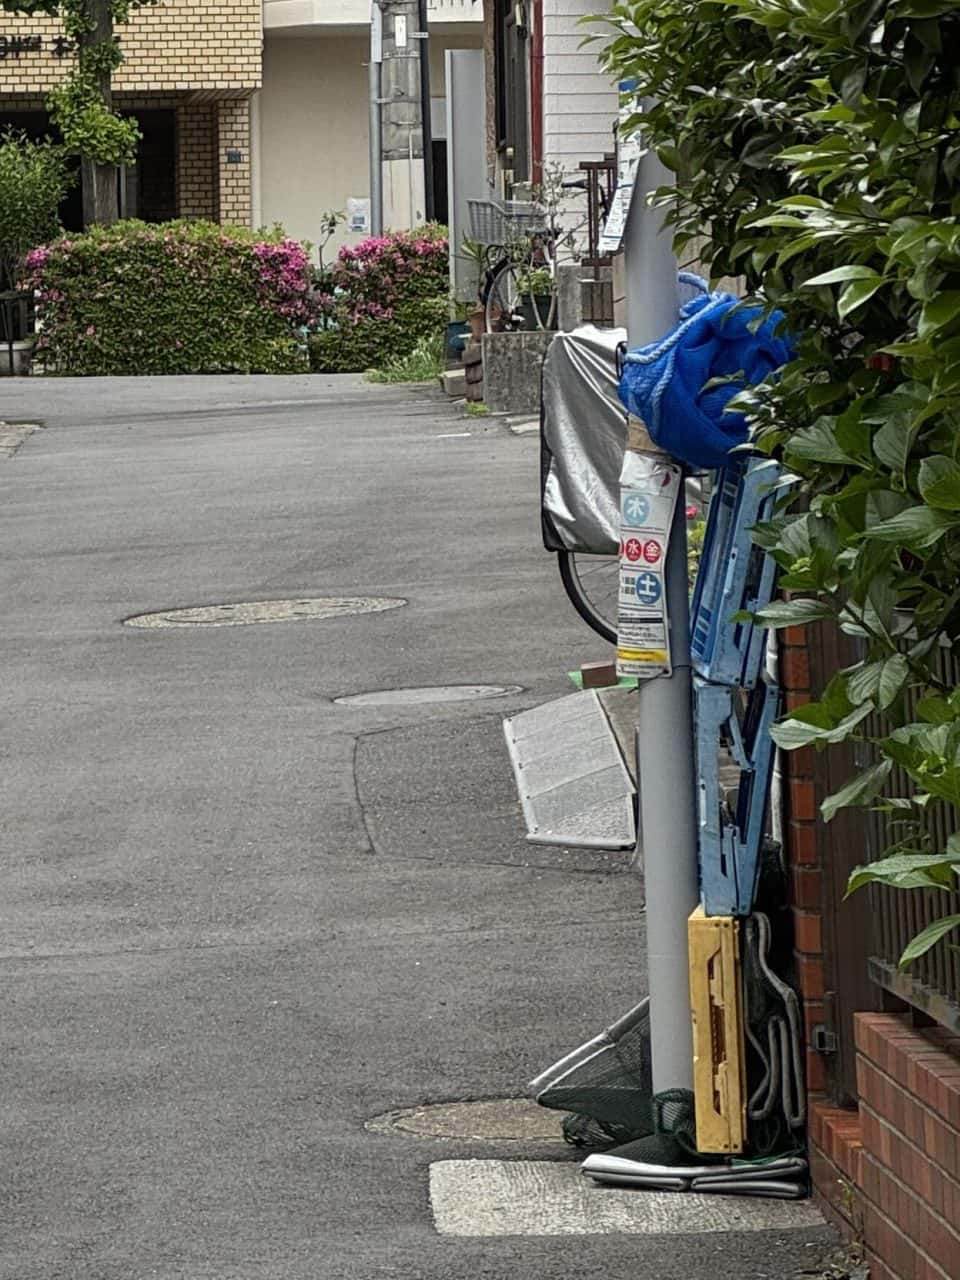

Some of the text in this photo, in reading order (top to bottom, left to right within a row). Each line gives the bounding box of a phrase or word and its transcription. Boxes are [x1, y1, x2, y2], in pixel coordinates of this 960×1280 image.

[627, 497, 645, 518] 木
[628, 540, 658, 557] 水 金
[639, 575, 656, 596] 土
